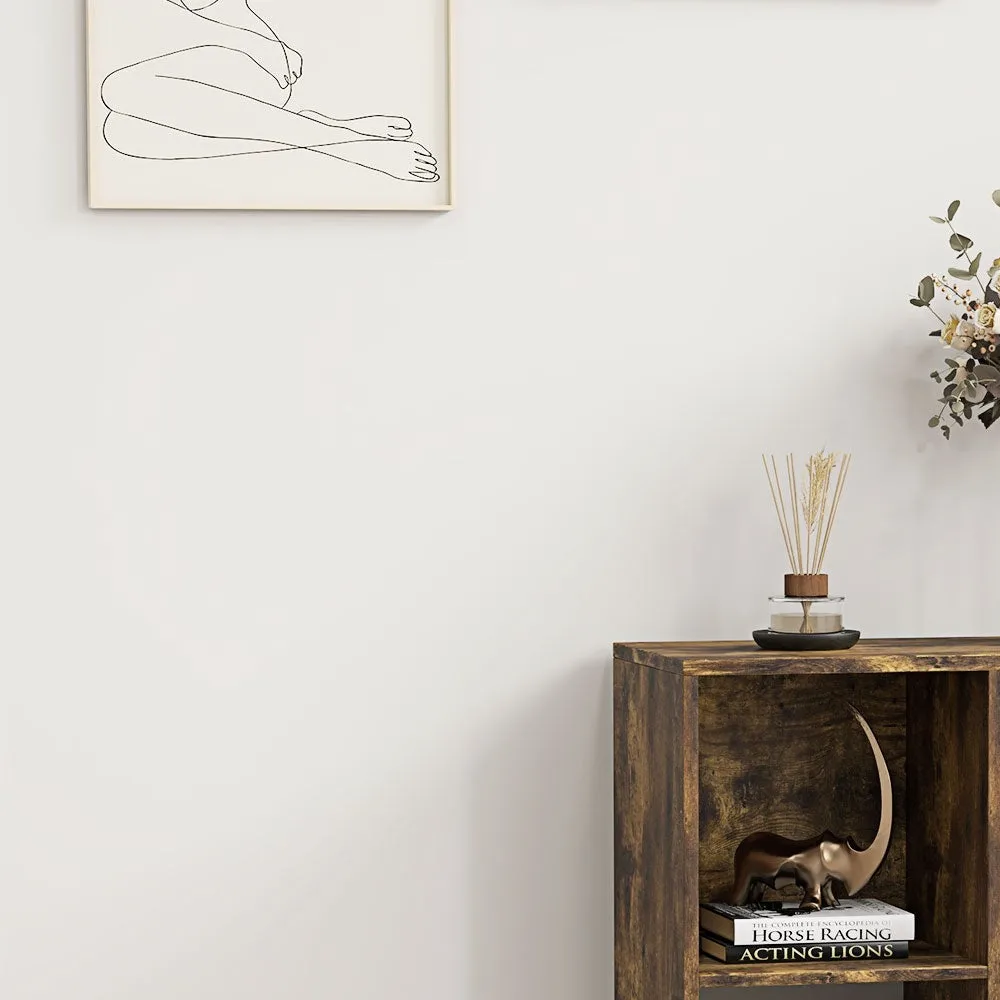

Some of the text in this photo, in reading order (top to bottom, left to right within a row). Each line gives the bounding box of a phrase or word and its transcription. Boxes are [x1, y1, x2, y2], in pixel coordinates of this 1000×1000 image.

[752, 928, 891, 942] HORSE RACING
[740, 944, 893, 961] ACTING LIONS
